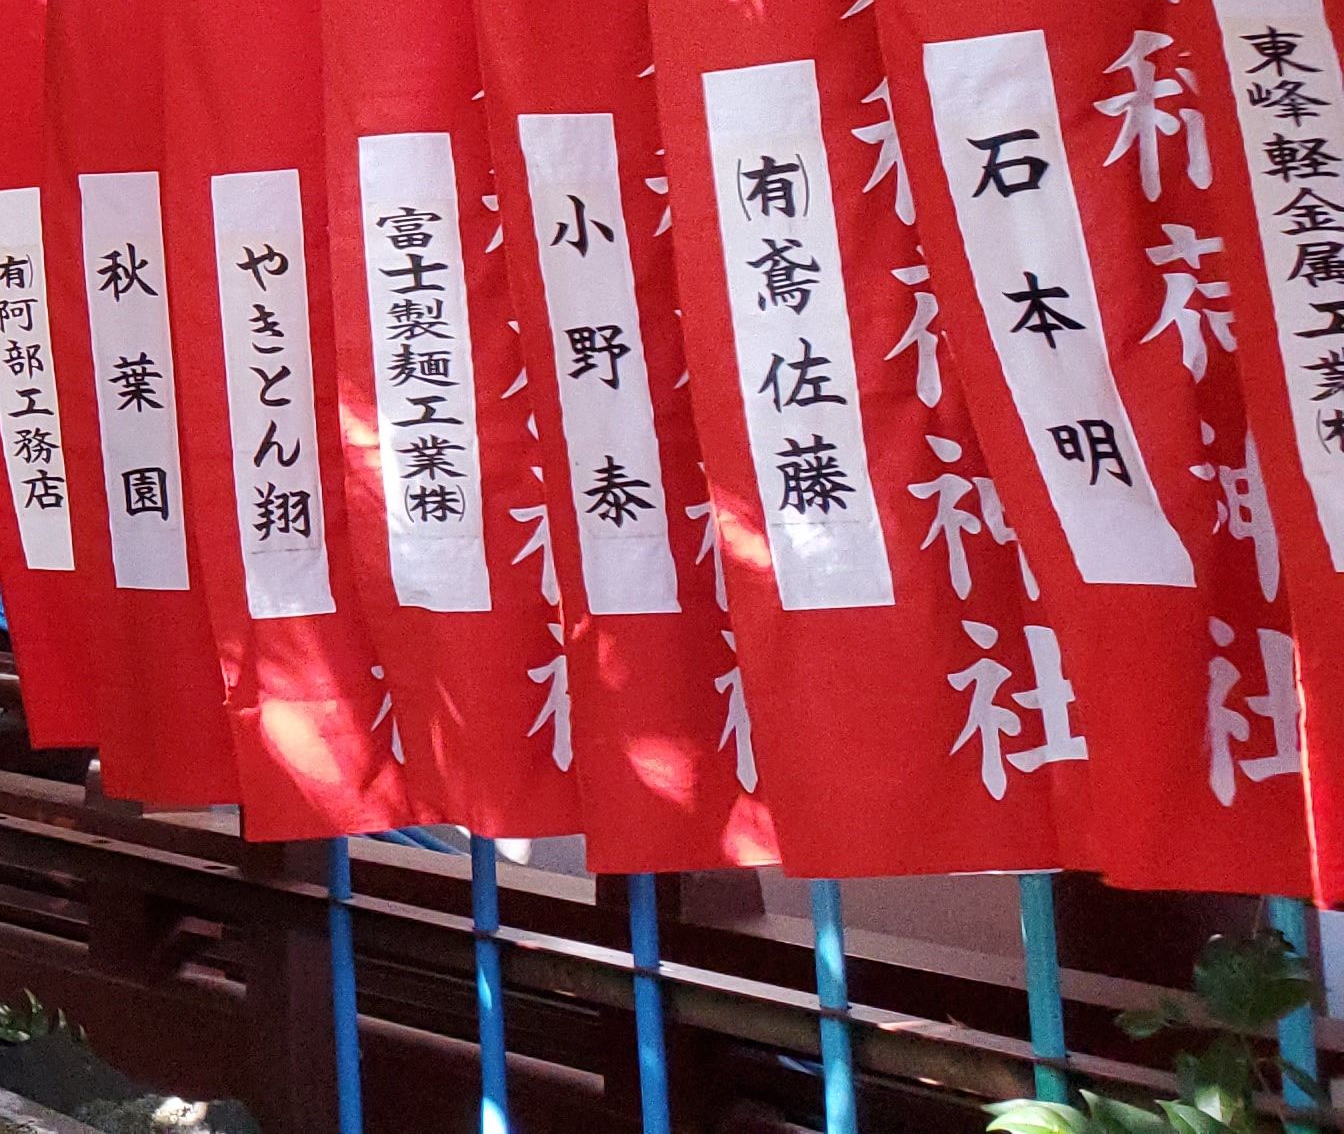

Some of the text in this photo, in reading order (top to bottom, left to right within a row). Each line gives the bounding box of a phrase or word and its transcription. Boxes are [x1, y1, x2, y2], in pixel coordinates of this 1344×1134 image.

[96, 241, 170, 522] 秋葉園
[239, 242, 312, 542] やきとん翔
[549, 194, 657, 528] 小野泰
[965, 128, 1135, 487] 石本明
